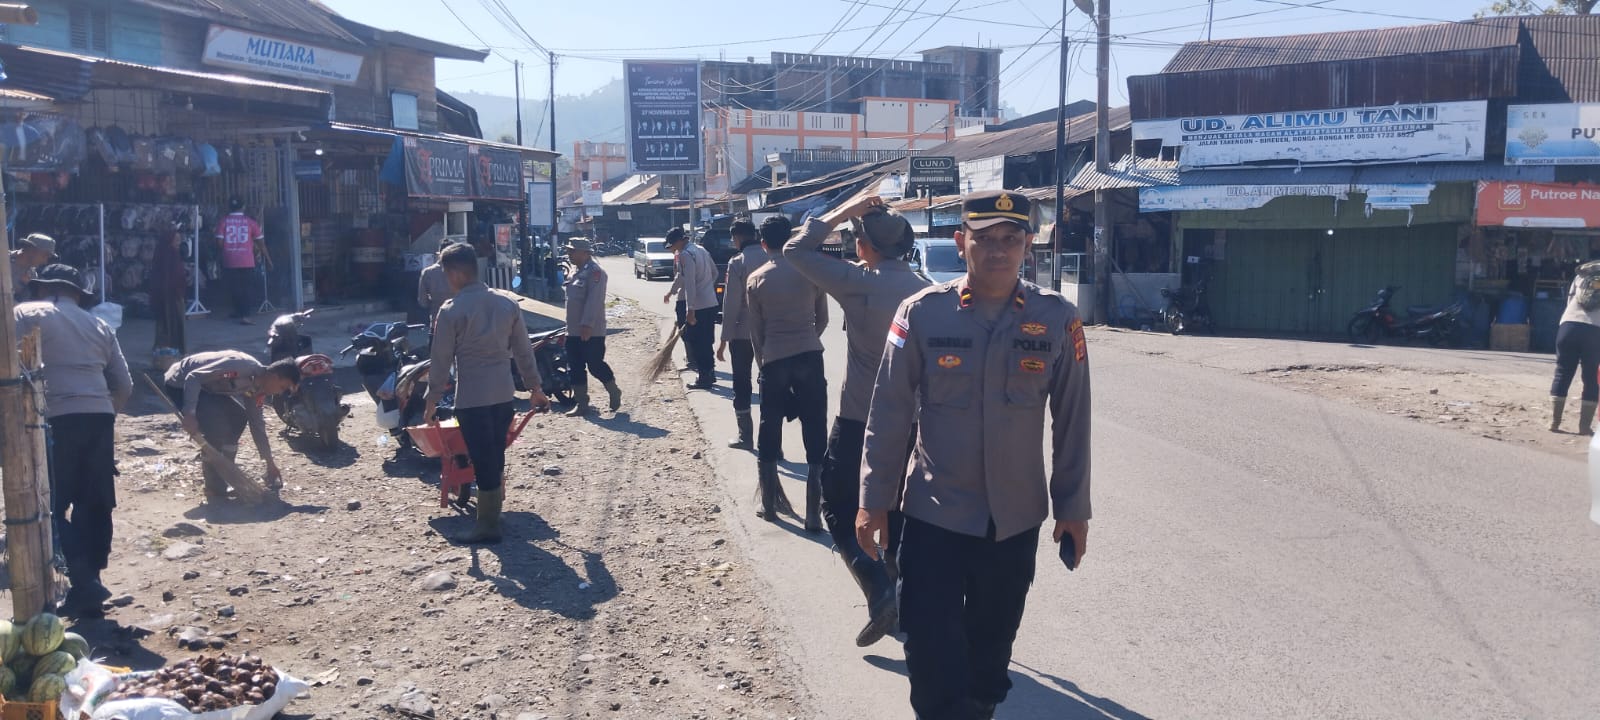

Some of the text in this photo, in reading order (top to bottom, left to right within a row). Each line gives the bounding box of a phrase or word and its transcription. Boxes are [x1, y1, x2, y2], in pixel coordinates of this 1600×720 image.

[246, 37, 315, 64] MUTIARA
[1181, 104, 1438, 133] UD. ALIMU TANI
[1572, 127, 1600, 140] PU
[1531, 189, 1577, 200] Putroe
[225, 225, 249, 243] 26
[1014, 338, 1053, 353] POLRI
